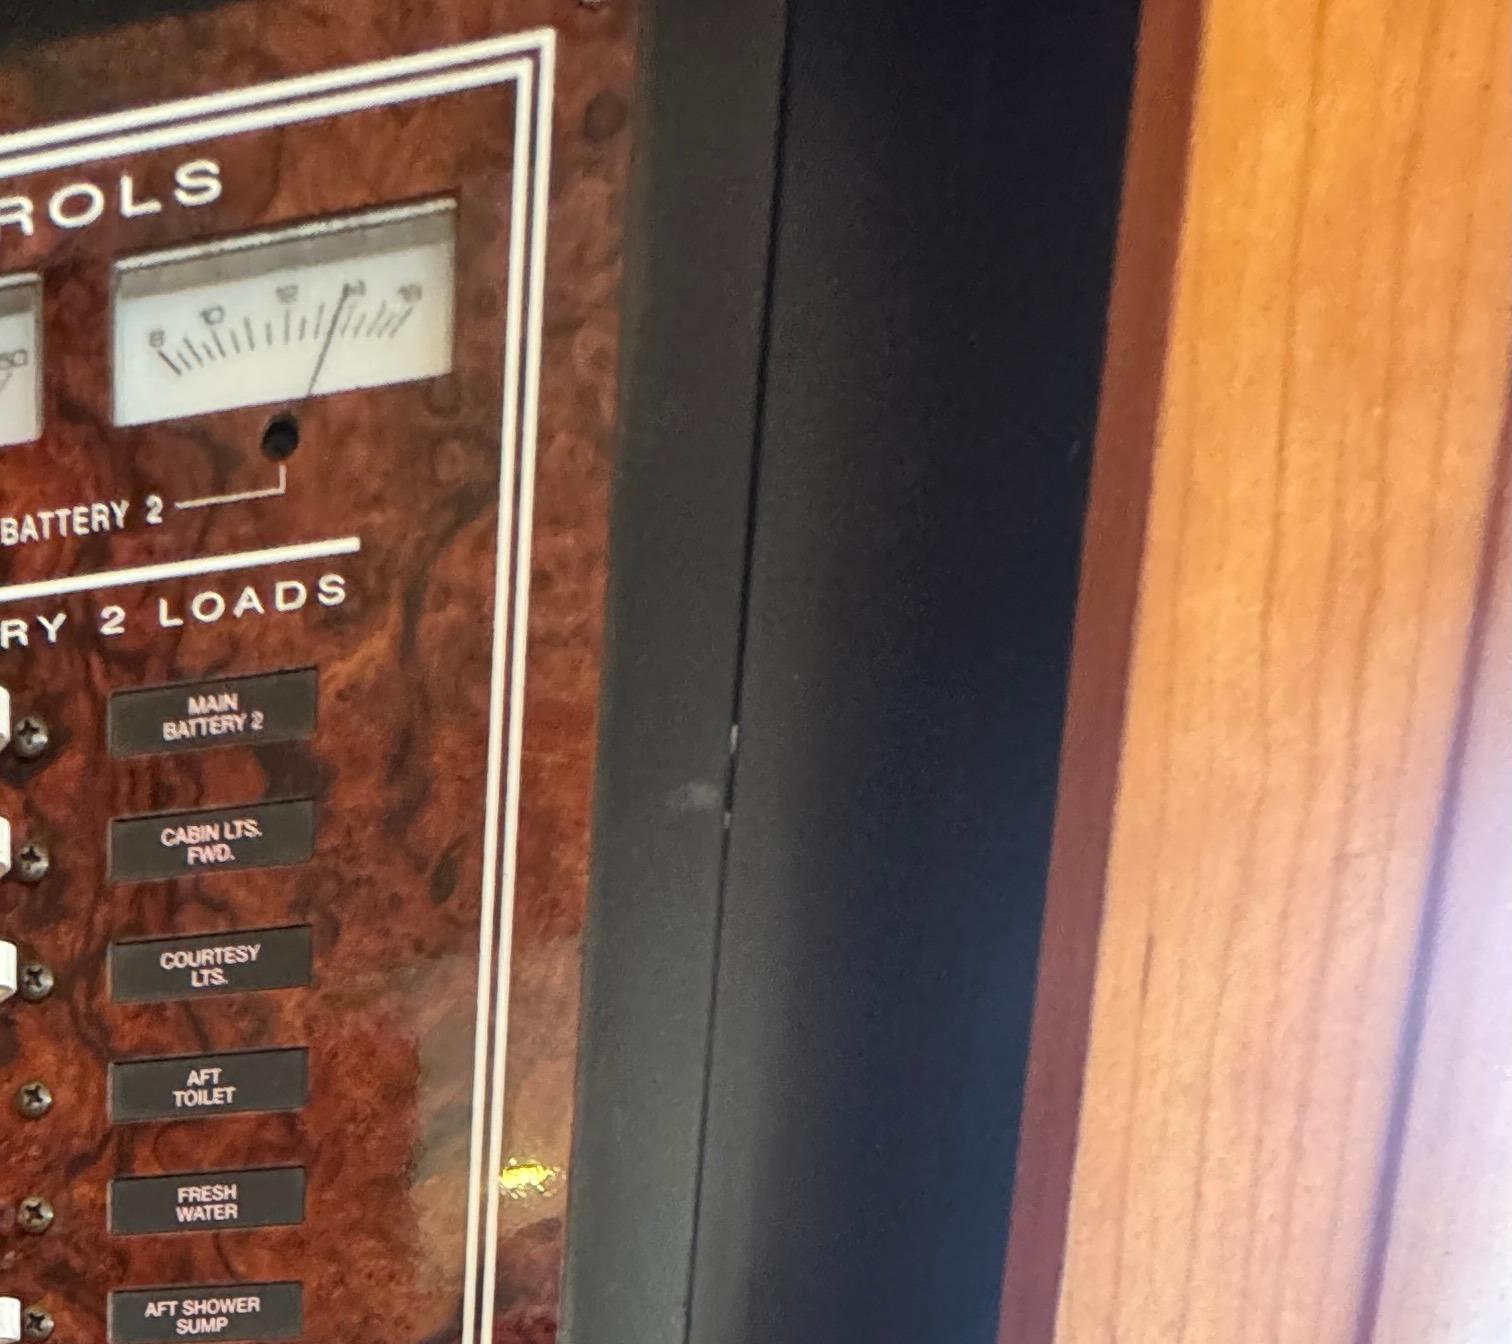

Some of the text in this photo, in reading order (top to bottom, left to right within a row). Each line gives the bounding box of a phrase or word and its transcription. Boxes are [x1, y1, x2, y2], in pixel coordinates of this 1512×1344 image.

[0, 496, 165, 547] BATTERY 2
[98, 605, 125, 635] 2
[158, 575, 349, 630] LOADS
[188, 693, 238, 715] MAIN
[162, 711, 264, 740] BATTERY 2
[160, 819, 263, 846] CABIN LTS.
[187, 844, 235, 864] FWD.
[160, 944, 261, 970] COURTESY
[191, 968, 228, 988] LTS.
[186, 1068, 222, 1086] AFT
[173, 1086, 236, 1107] TOILET
[177, 1184, 237, 1203] FRESH
[176, 1204, 238, 1222] WATER
[144, 1297, 261, 1318] AFT SHOWER
[176, 1317, 228, 1335] SUMP
